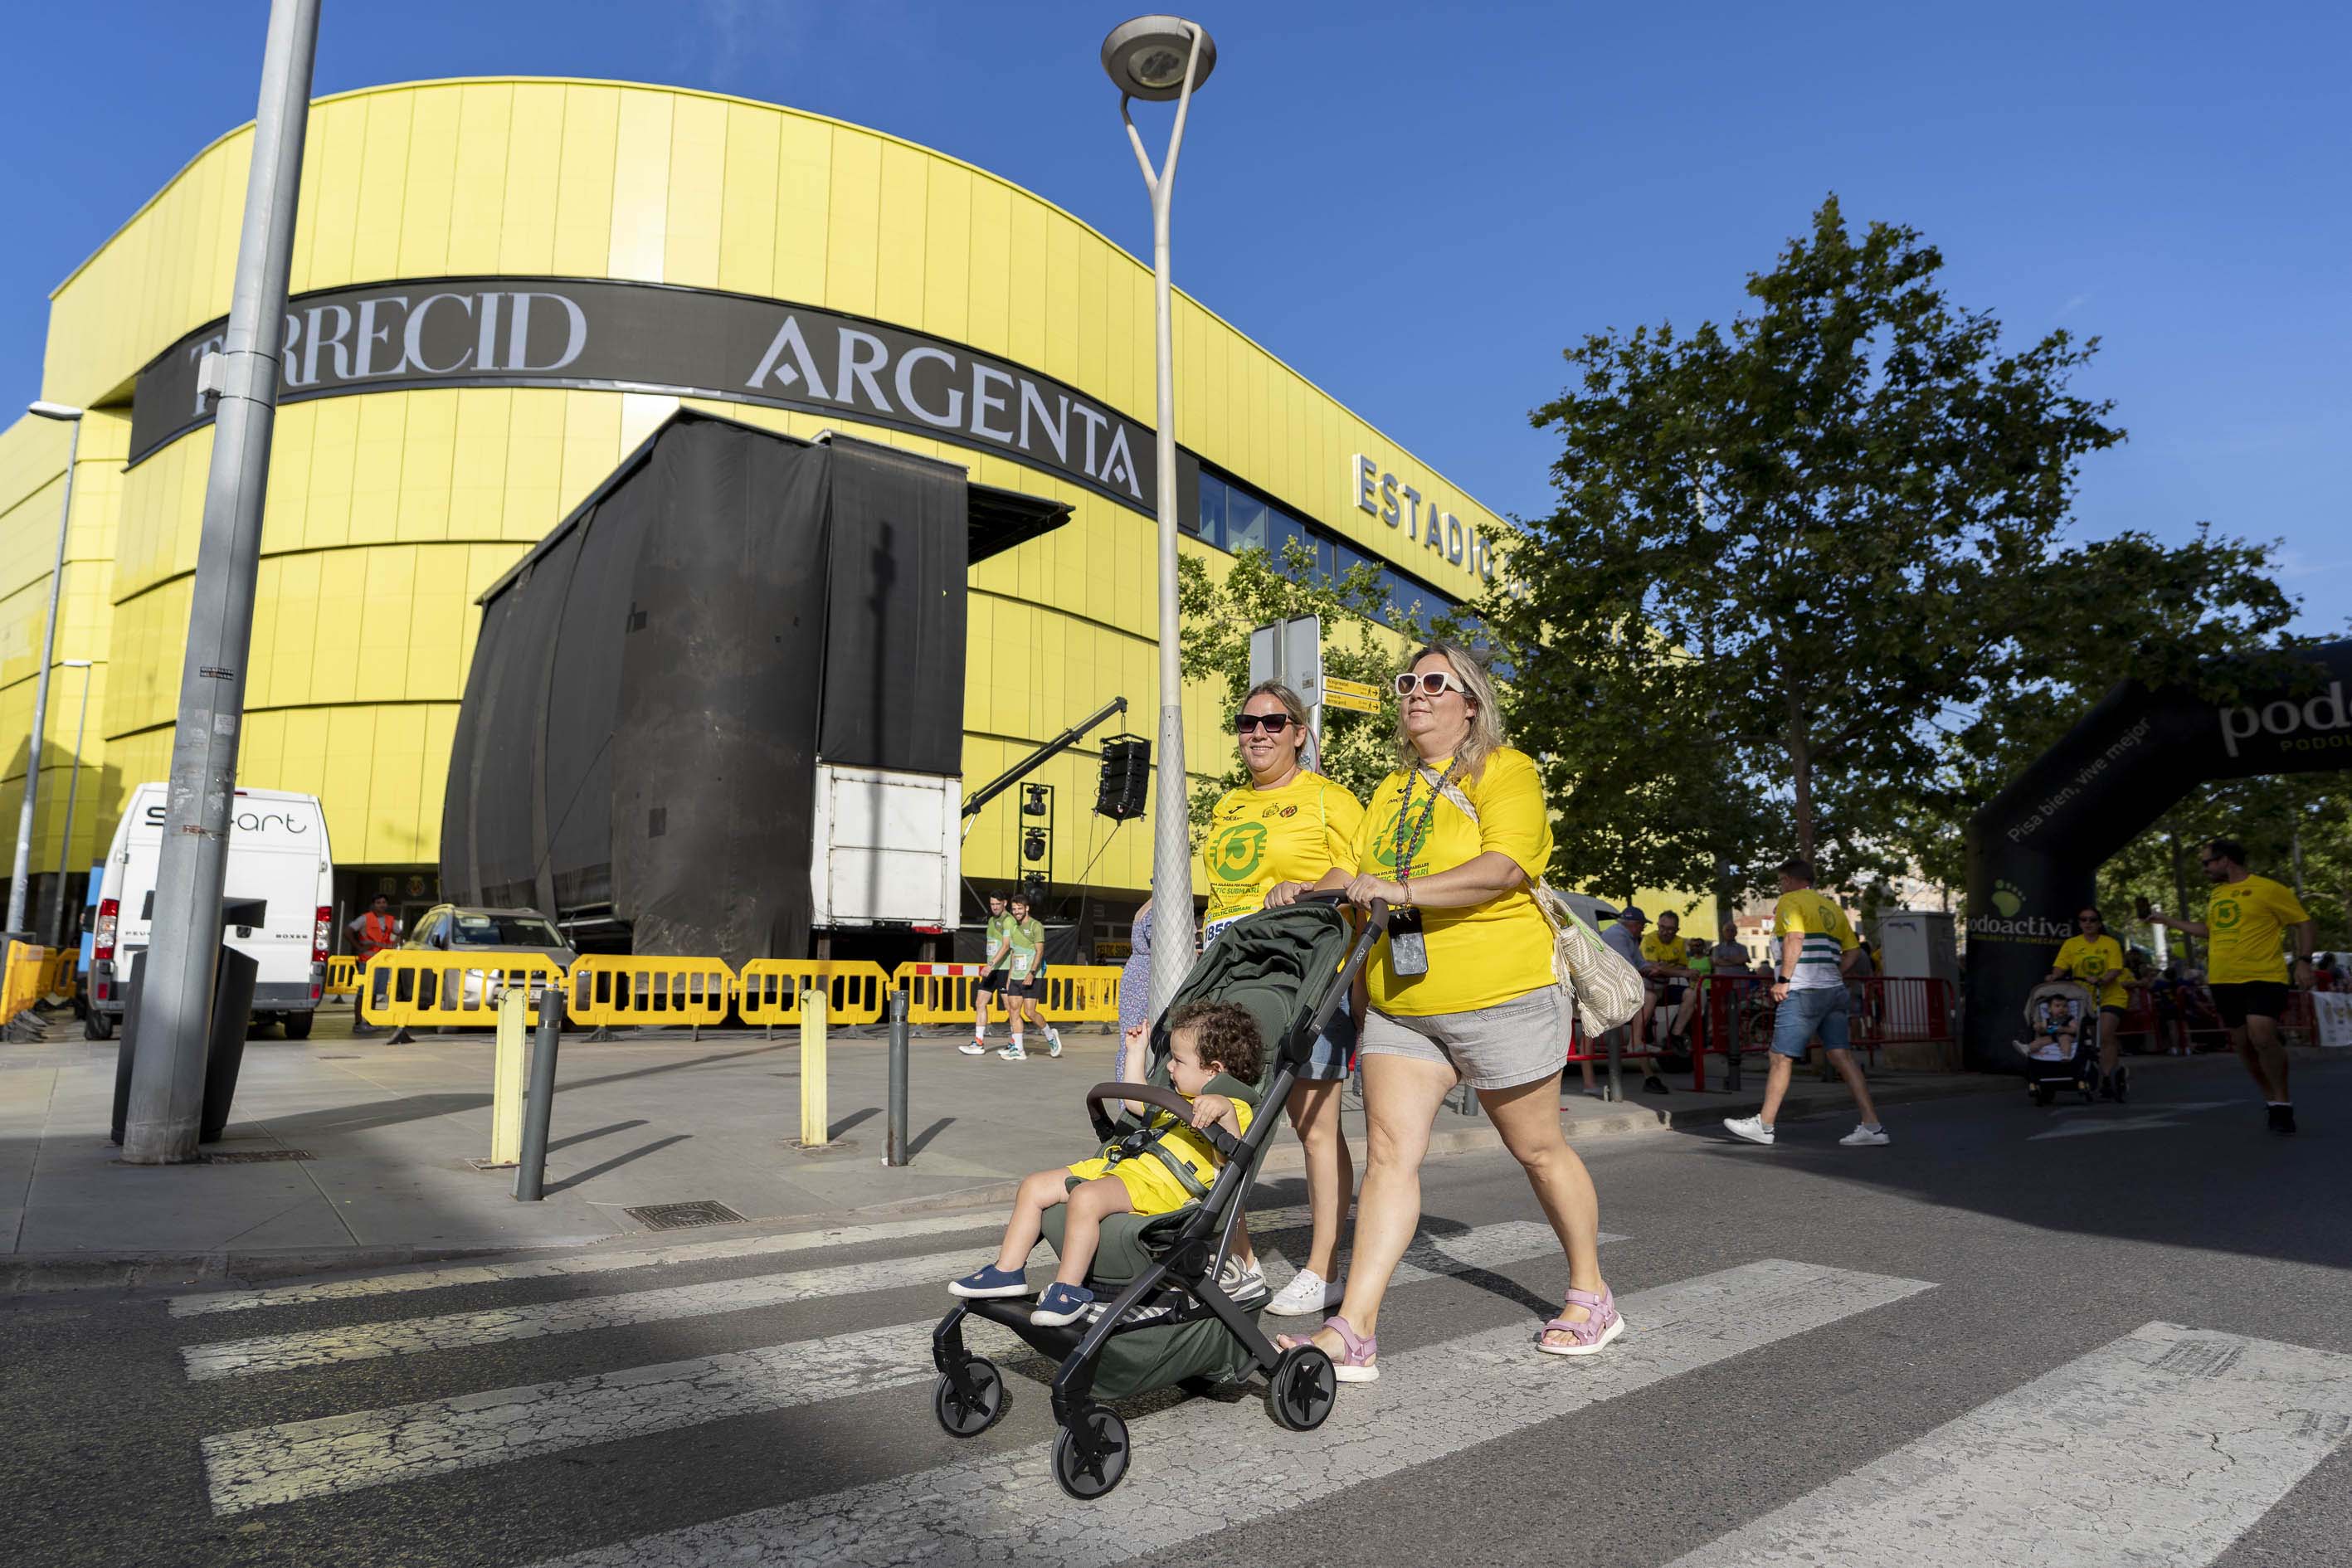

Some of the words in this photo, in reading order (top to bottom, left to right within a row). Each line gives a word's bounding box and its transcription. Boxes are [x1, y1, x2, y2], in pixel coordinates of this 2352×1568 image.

[190, 292, 587, 416] TRRECID
[745, 315, 1142, 499] ARGENTA
[1352, 453, 1494, 583] ESTADIO
[2007, 814, 2044, 843] Pisa
[2038, 786, 2082, 816] bien,
[2074, 757, 2108, 784] vive
[2105, 717, 2151, 761] mejor
[2218, 680, 2352, 757] pod
